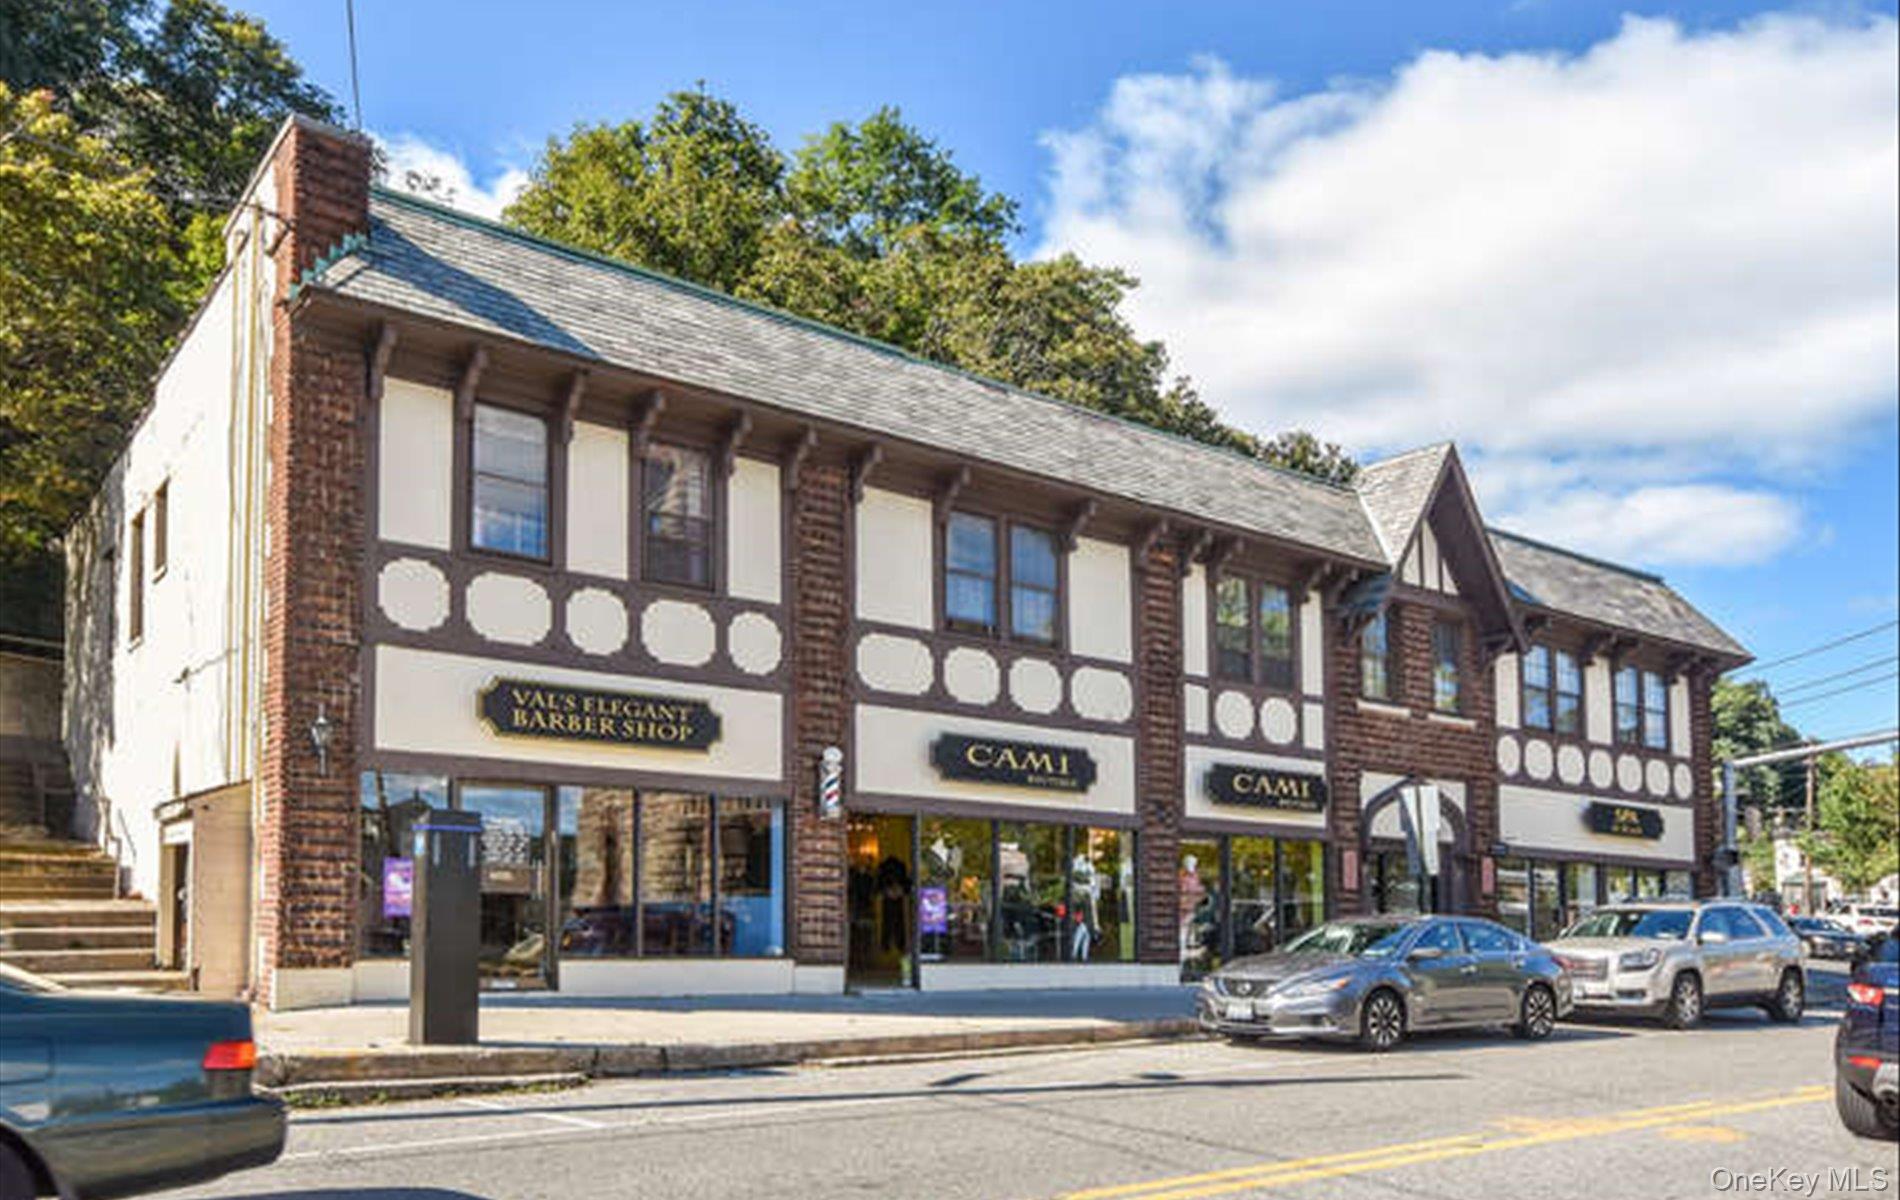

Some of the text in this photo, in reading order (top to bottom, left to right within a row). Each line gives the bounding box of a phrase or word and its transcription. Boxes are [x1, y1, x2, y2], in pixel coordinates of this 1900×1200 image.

[512, 689, 690, 721] VAL'S ELEGANT
[512, 709, 693, 742] BARBER SHOP
[966, 744, 1069, 775] CAMI
[1232, 773, 1309, 799] CAMI
